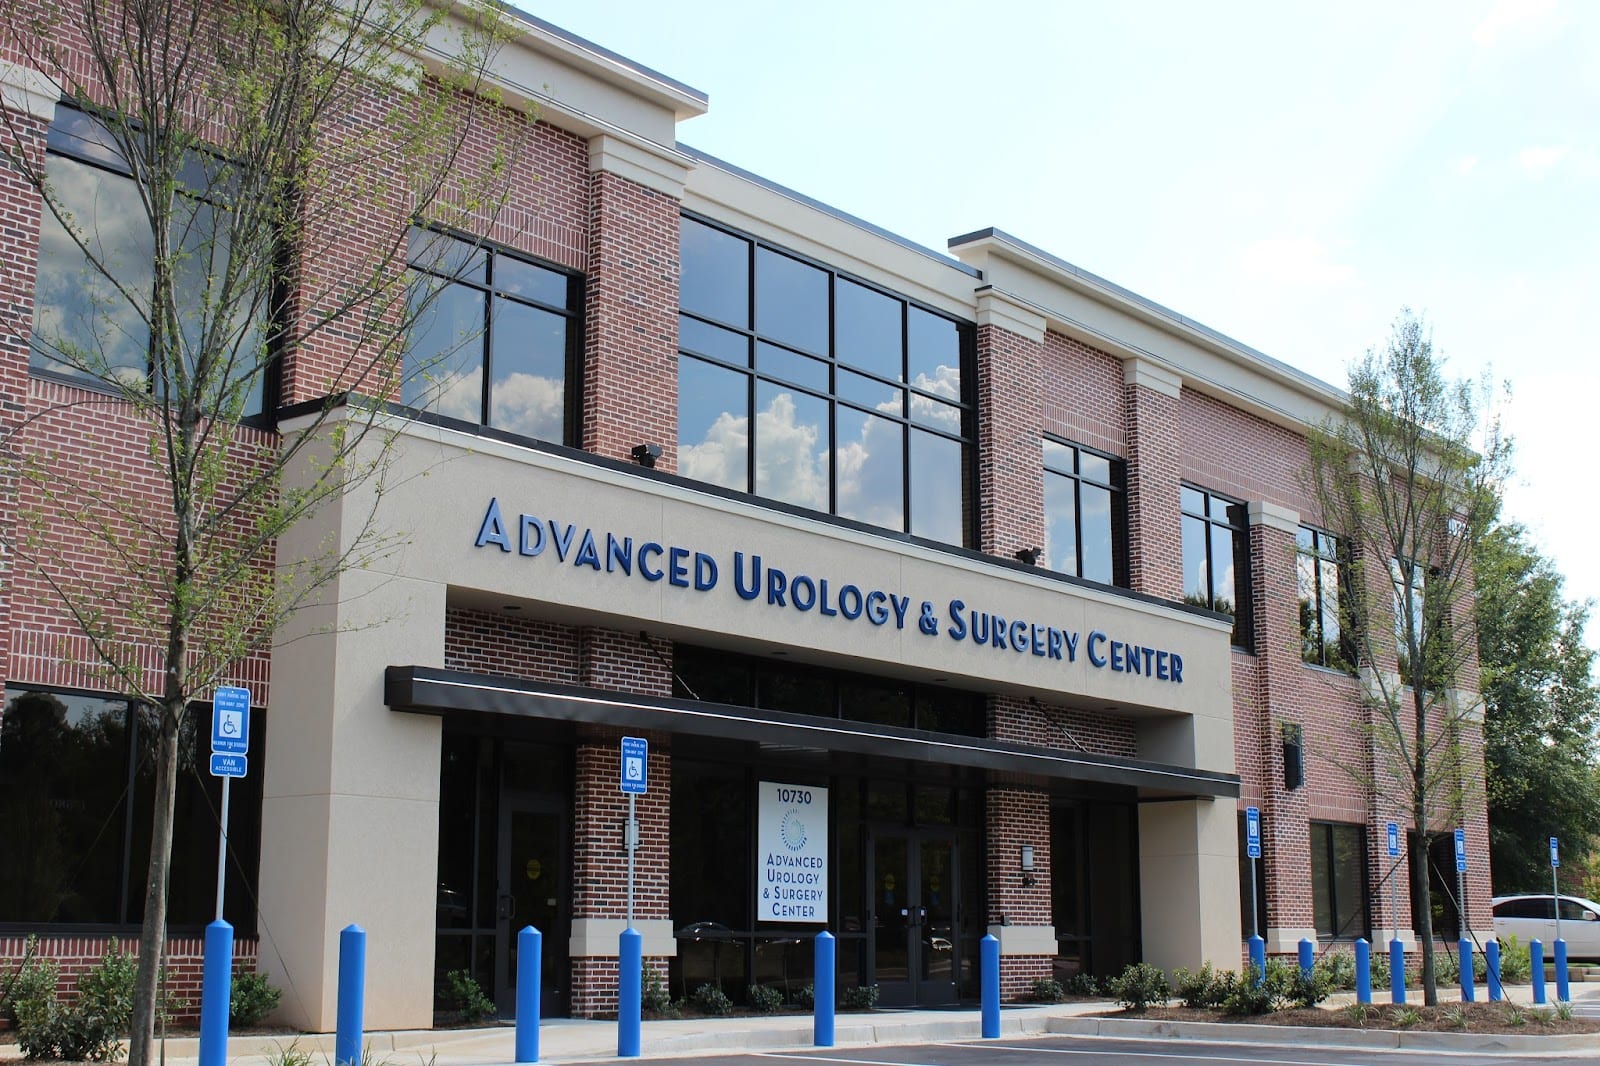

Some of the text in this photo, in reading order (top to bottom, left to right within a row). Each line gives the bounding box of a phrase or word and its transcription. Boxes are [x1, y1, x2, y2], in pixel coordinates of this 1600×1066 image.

[475, 497, 1184, 683] ADVANCED UROLOGY & SURGERY CENTER
[222, 759, 236, 767] VAN
[777, 788, 812, 804] 10730
[767, 853, 823, 869] ADVANCED
[767, 869, 820, 885] UROLOGY
[763, 886, 823, 901] & SURGERY
[772, 903, 815, 917] CENTER
